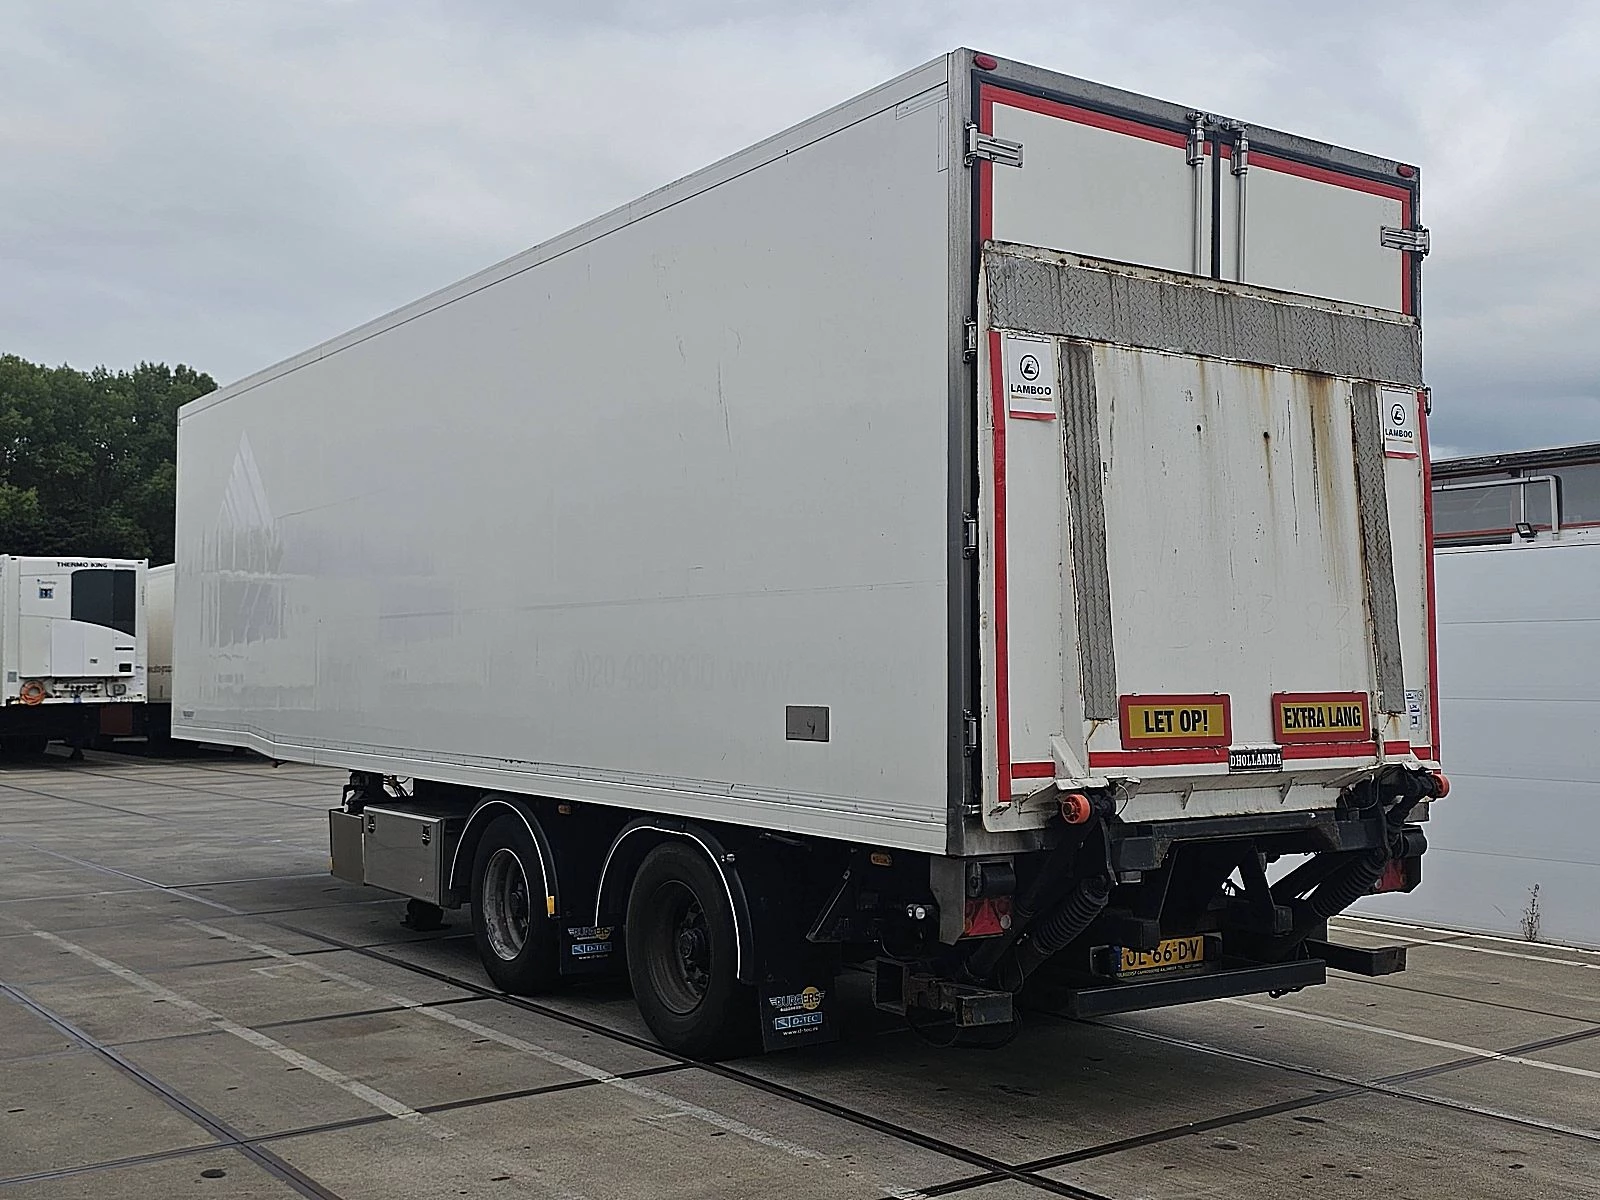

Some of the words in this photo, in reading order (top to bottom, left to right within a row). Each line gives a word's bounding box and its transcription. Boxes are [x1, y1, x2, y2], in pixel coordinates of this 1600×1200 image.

[1010, 383, 1052, 396] LAMBOO
[1385, 428, 1413, 438] LAMBOO
[1144, 710, 1174, 732] LET
[1180, 709, 1208, 732] OP!
[1283, 707, 1326, 728] EXTRA
[1327, 706, 1362, 728] LANG
[1230, 753, 1282, 767] DHOLLANDIA
[776, 991, 820, 1008] BURGERS
[793, 1015, 818, 1025] D-TEC
